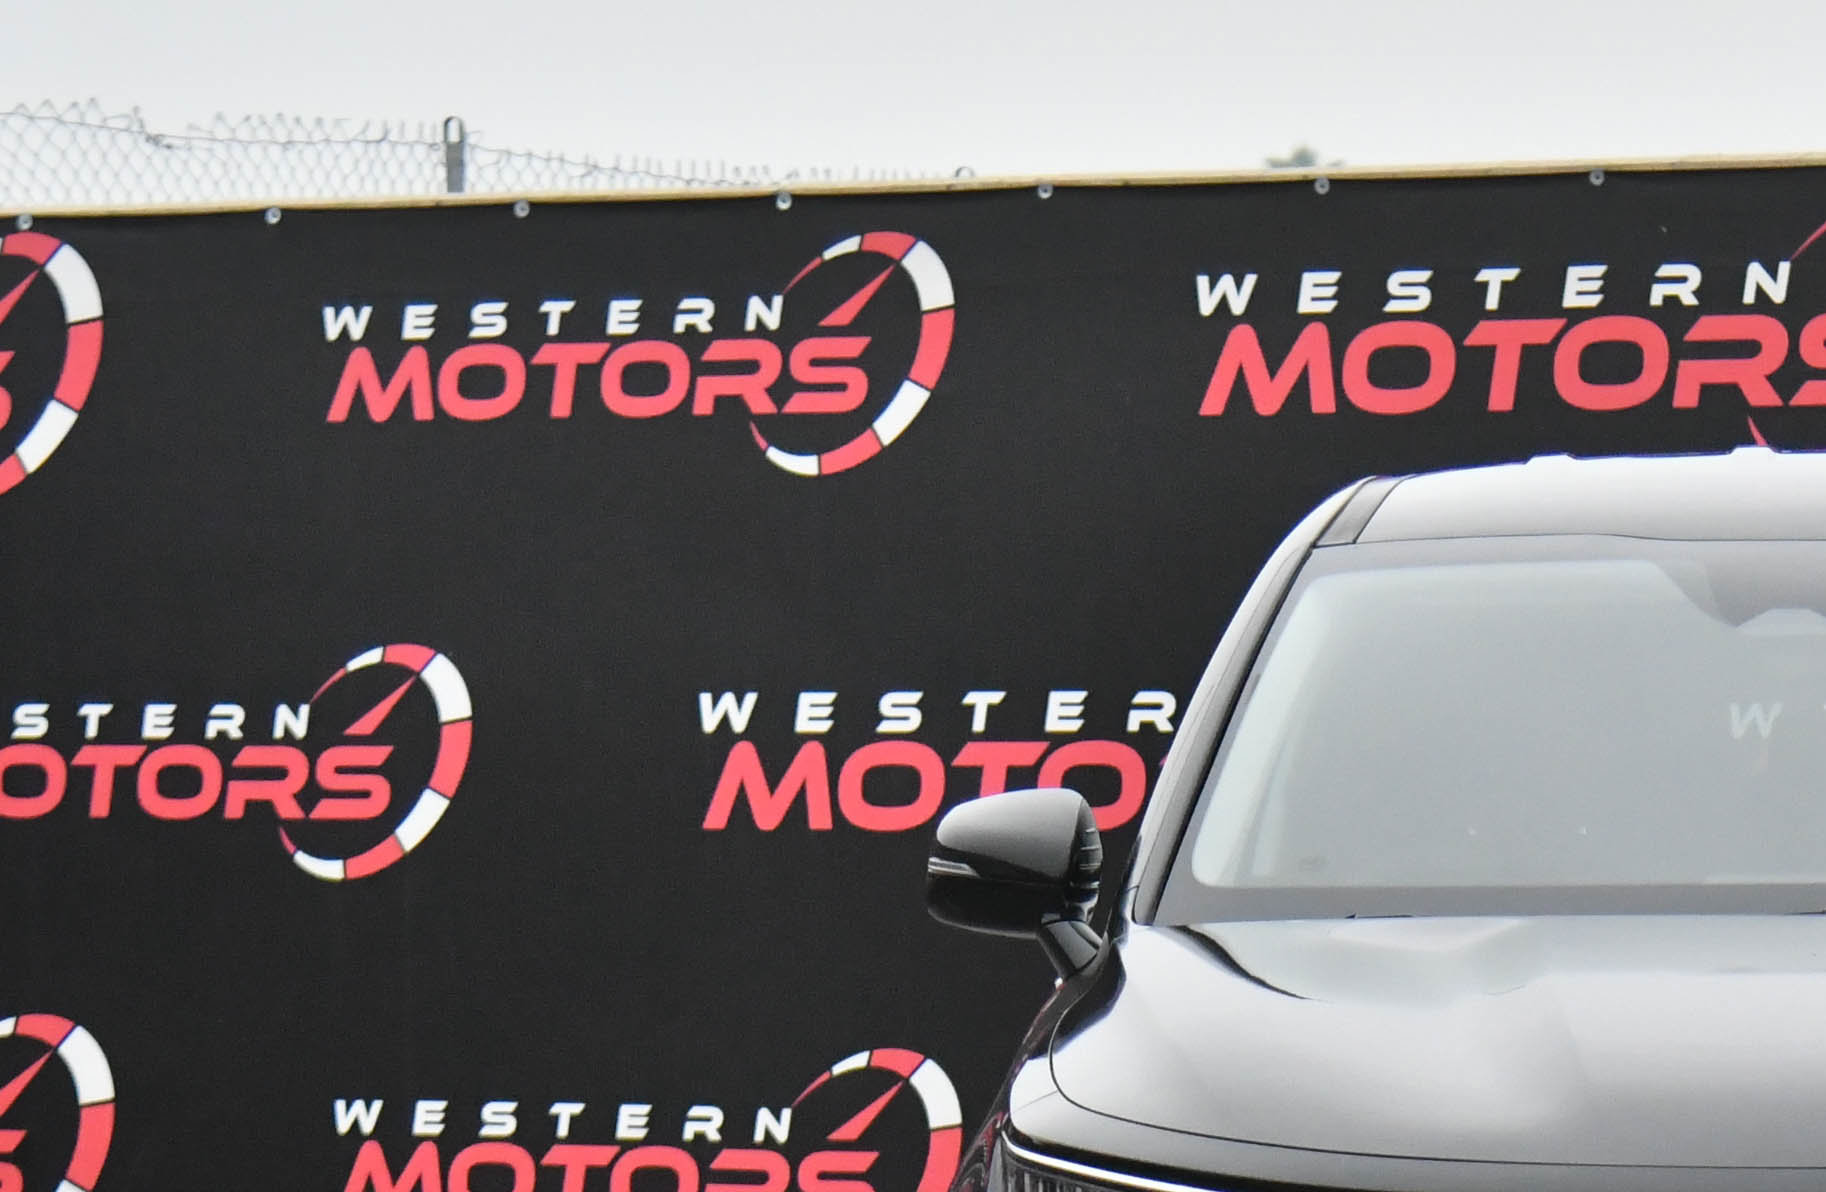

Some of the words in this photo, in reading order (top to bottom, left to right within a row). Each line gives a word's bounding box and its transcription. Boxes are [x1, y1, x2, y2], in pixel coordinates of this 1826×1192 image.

[1195, 260, 1793, 317] WESTERN
[323, 294, 784, 342] WESTERN
[327, 337, 872, 423] MOTORS
[702, 739, 1168, 833] MOTO
[334, 1098, 793, 1144] WESTERN
